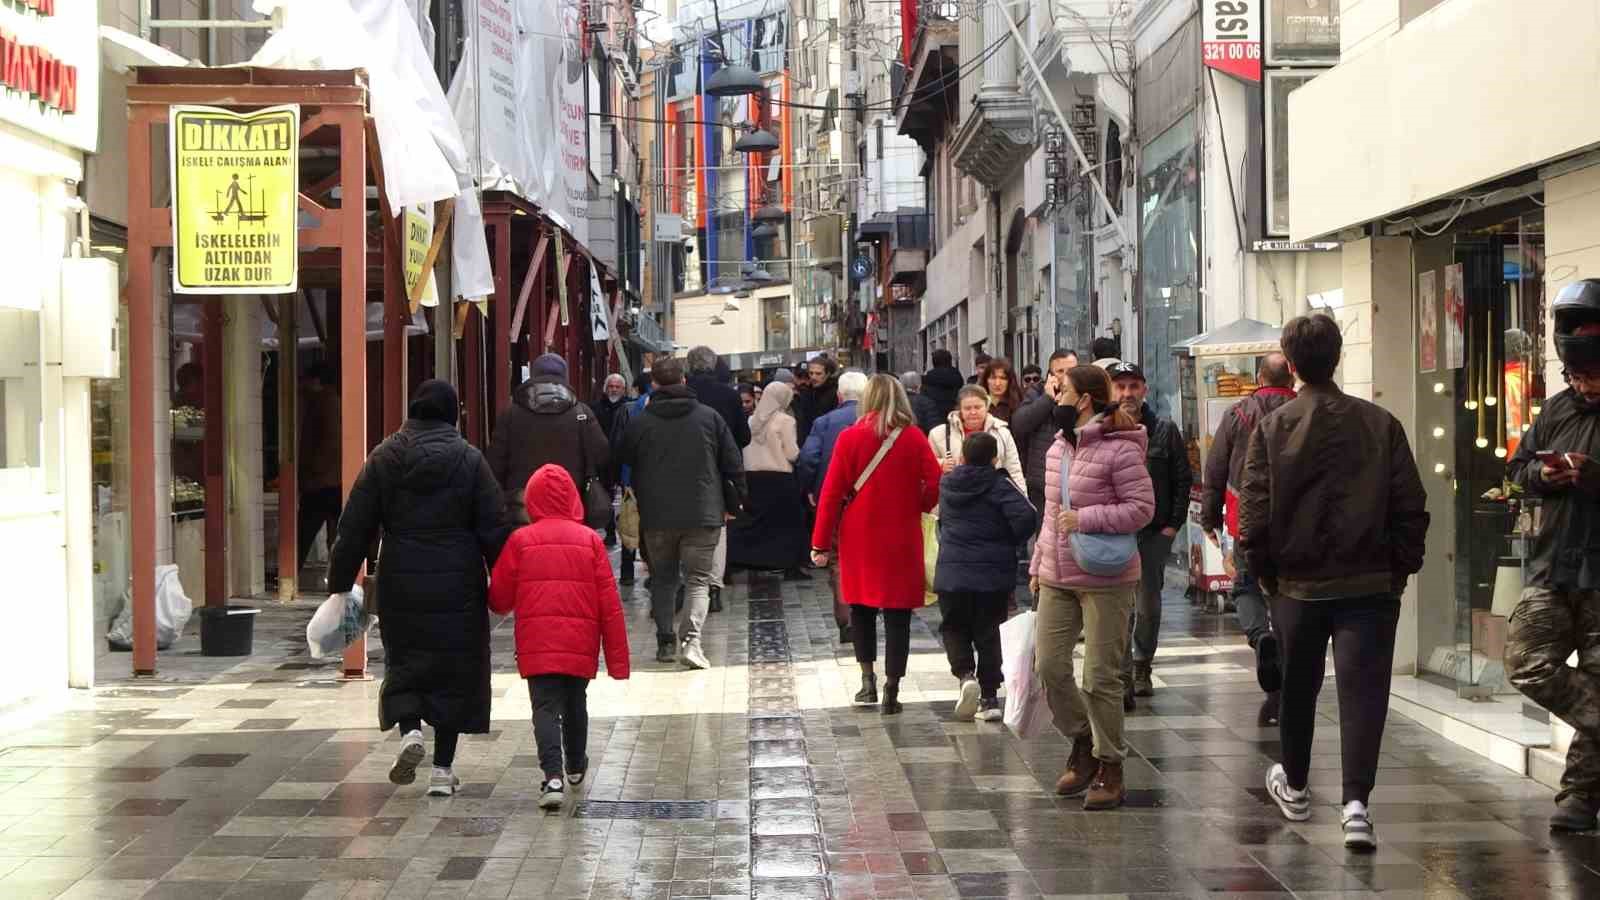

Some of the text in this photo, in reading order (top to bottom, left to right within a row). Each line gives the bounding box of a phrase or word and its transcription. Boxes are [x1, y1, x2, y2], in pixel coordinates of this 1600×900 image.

[1204, 43, 1260, 59] 321 00 06
[184, 119, 288, 150] DİKKAT!
[195, 232, 280, 248] İSKELELERİN
[205, 251, 272, 265] ALTINDAN
[204, 267, 272, 281] UZAK DUR
